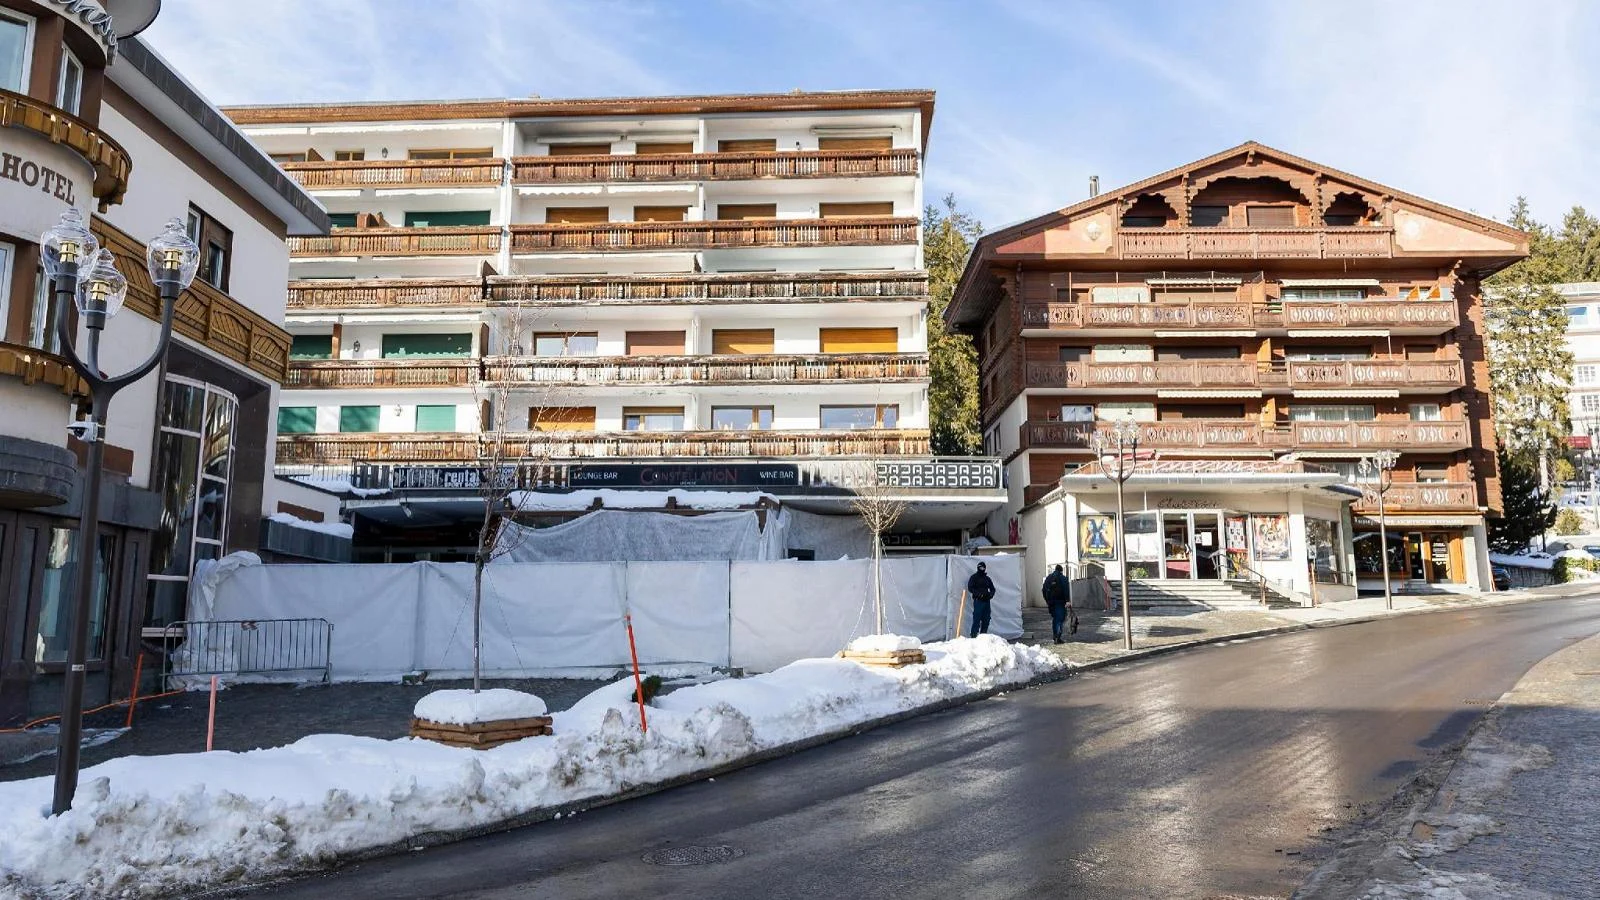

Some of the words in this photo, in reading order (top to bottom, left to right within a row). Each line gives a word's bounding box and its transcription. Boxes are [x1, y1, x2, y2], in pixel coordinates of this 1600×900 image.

[2, 152, 75, 206] HOTEL
[573, 471, 602, 480] LOUNGE
[603, 471, 618, 480] BAR
[759, 470, 778, 480] WINE
[779, 470, 794, 480] BAR
